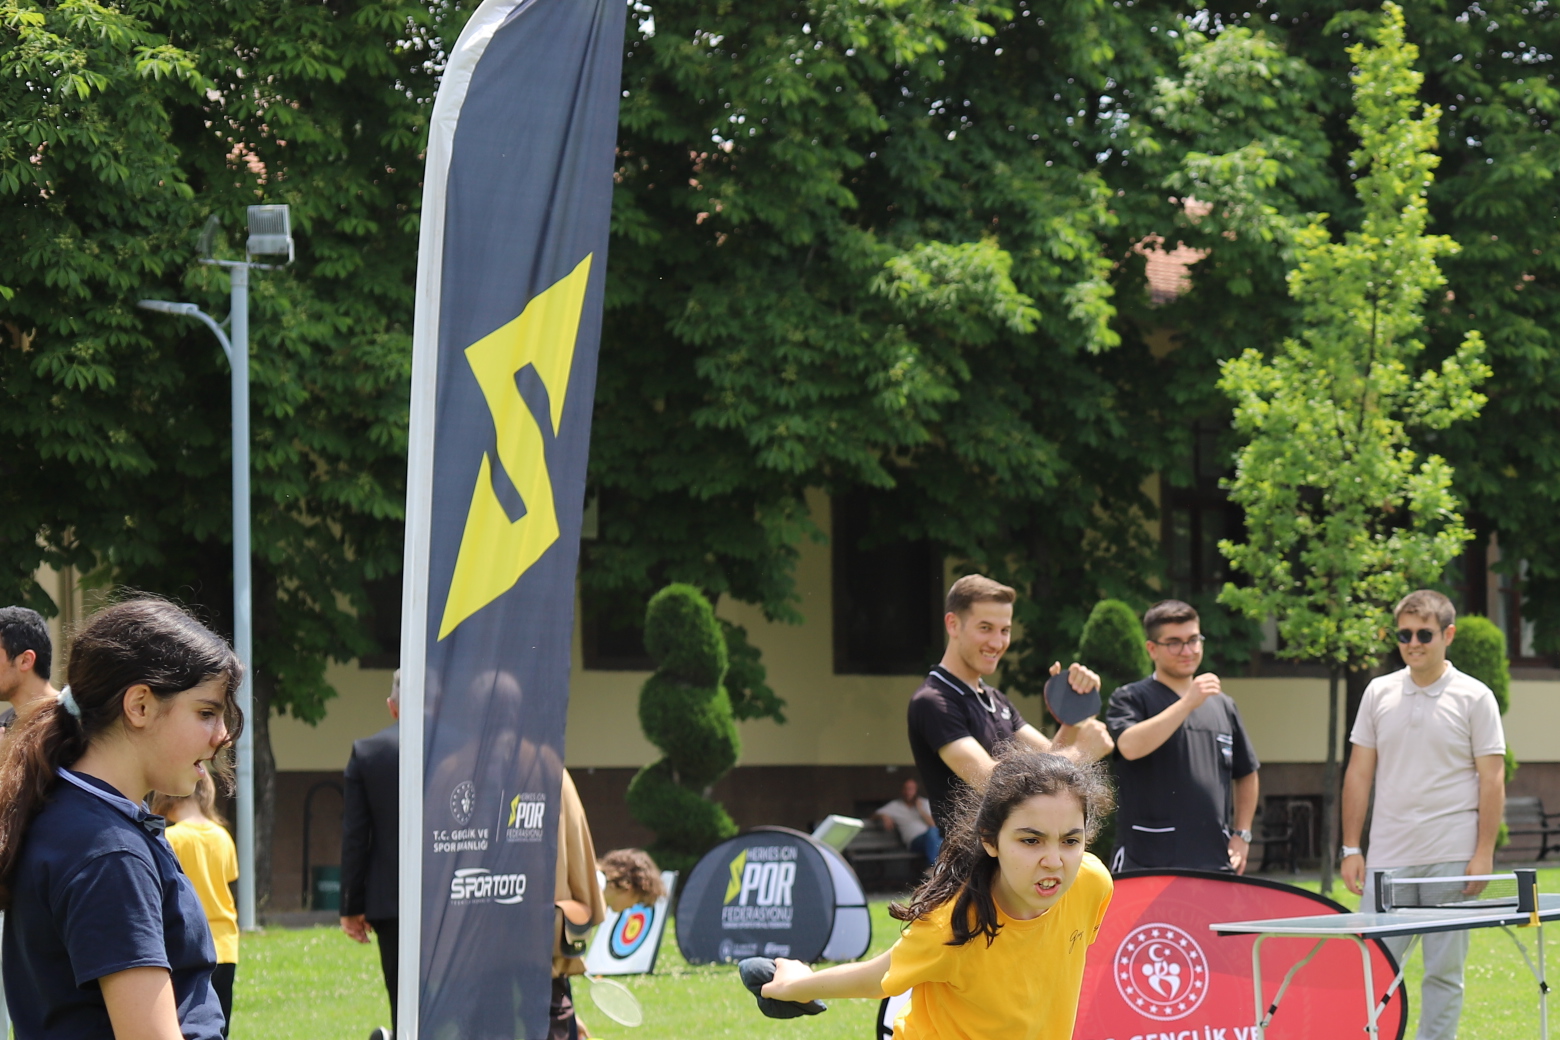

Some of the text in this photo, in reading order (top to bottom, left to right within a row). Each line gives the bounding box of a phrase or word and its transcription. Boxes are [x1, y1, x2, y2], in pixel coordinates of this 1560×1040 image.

[433, 830, 450, 841] T.C.
[477, 828, 489, 839] VE
[433, 842, 456, 853] SPOR
[450, 872, 526, 900] SPORTOTO
[724, 849, 797, 906] SPOR
